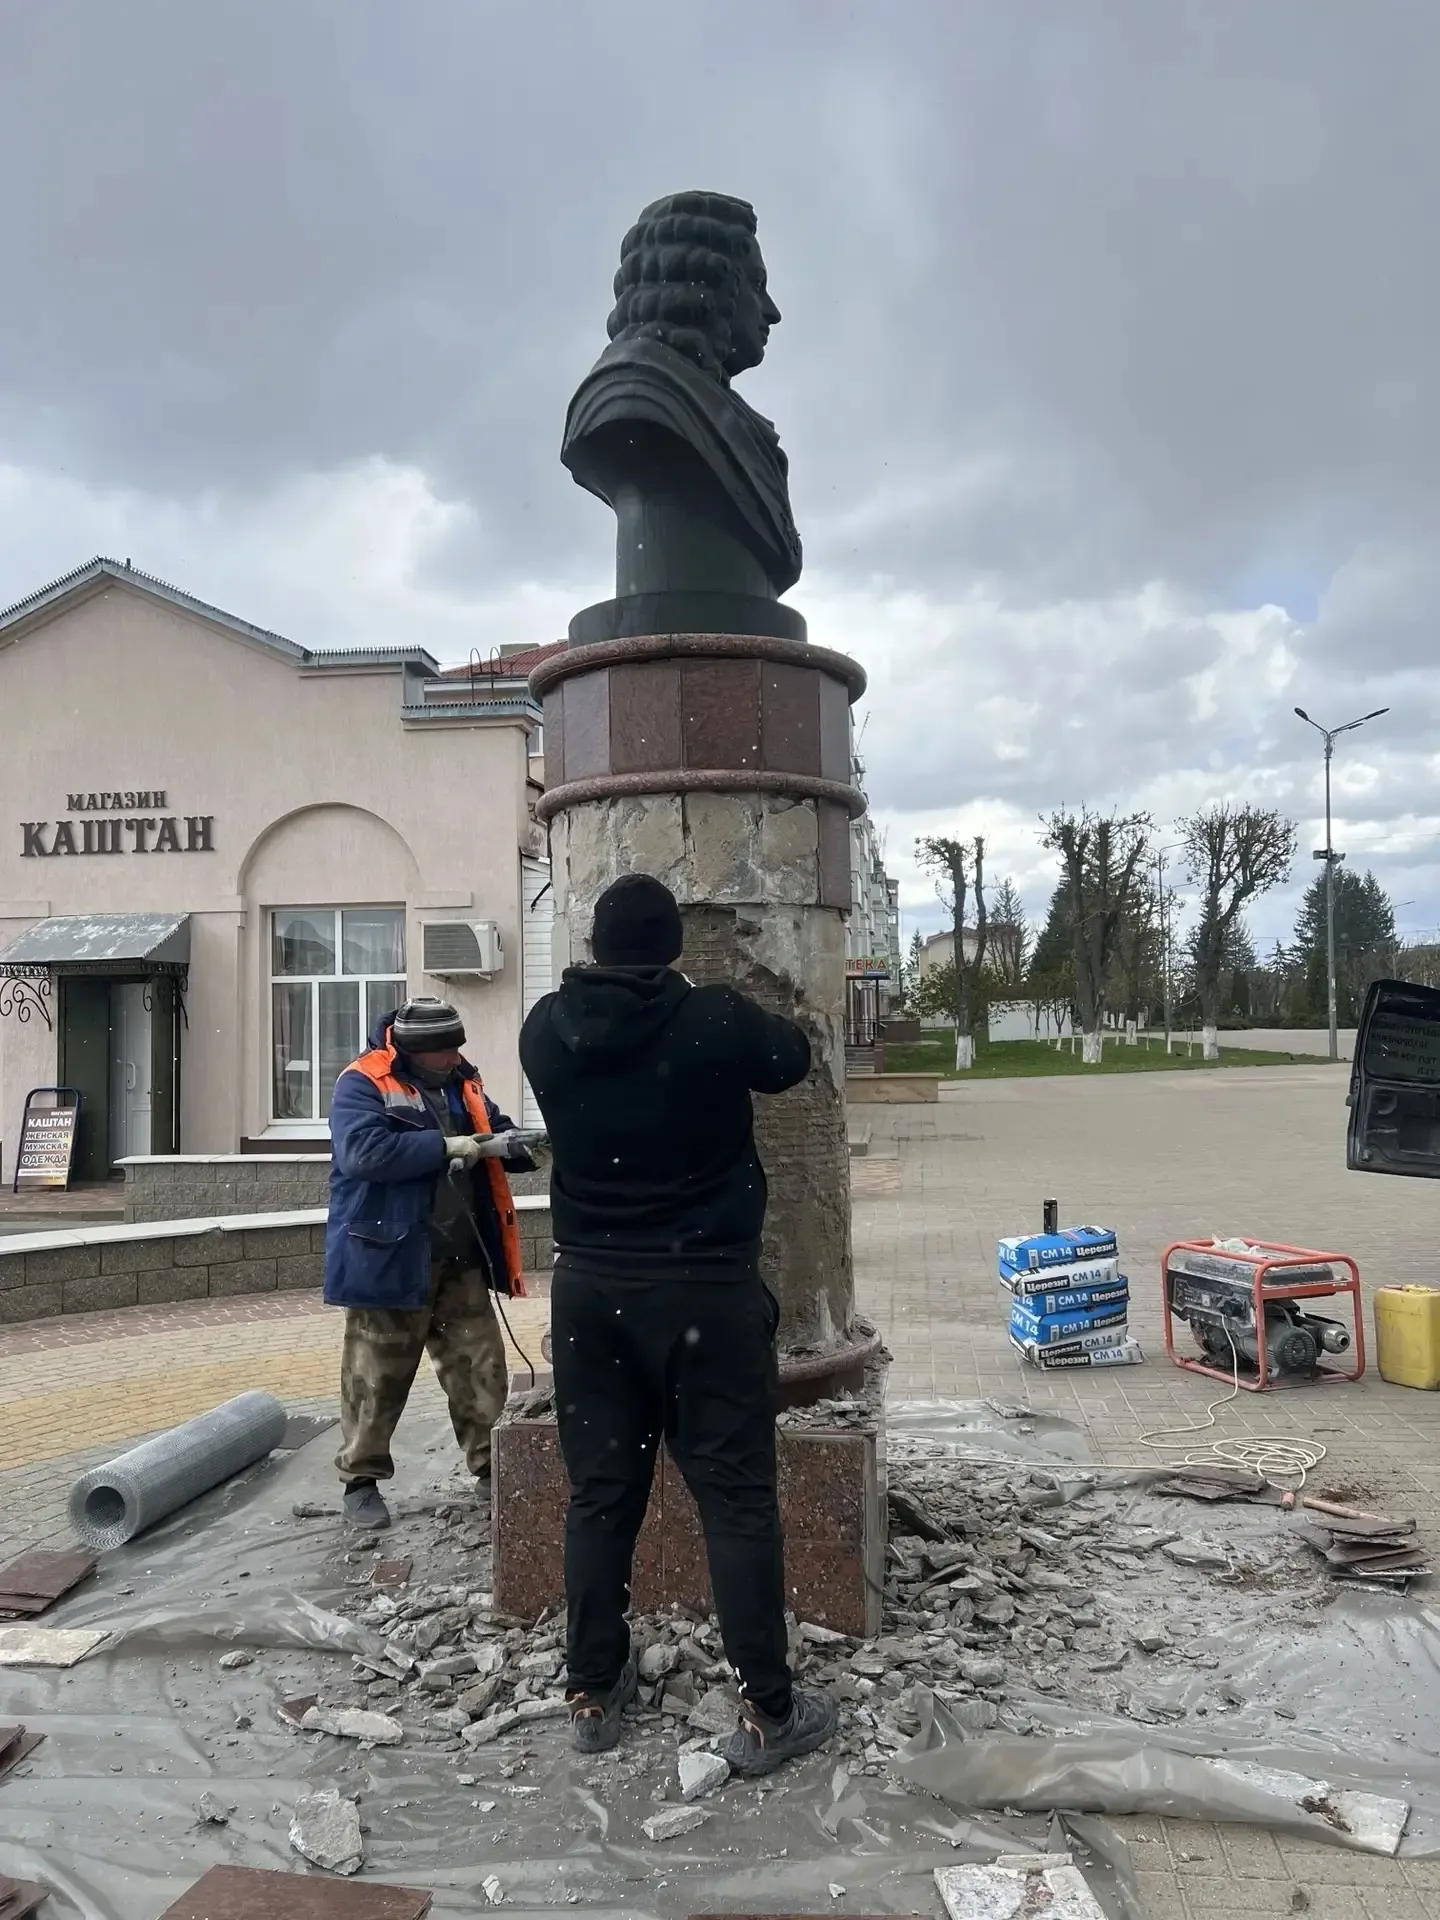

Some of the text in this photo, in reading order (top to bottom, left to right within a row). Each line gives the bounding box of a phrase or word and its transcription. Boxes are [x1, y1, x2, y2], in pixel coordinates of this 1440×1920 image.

[66, 790, 168, 811] МАГАЗИН
[19, 816, 215, 857] КАШТАН
[28, 1118, 72, 1128] КАШТАН
[26, 1131, 70, 1140] ЖЕНСКАЯ
[24, 1142, 69, 1151] МУЖСКАЯ
[22, 1154, 68, 1165] ОДЕЖДА
[1060, 1247, 1072, 1257] 14
[1076, 1243, 1115, 1257] Церезит
[1089, 1269, 1101, 1280] 14
[1025, 1279, 1069, 1292] Церезит
[1075, 1292, 1088, 1303] 14
[1091, 1288, 1128, 1302] Церезит
[1079, 1319, 1090, 1330] 14
[1093, 1312, 1127, 1328] Церезит
[1026, 1319, 1039, 1336] 14
[1101, 1335, 1113, 1345] 14
[1111, 1349, 1124, 1359] 14
[1046, 1355, 1090, 1367] Церезит
